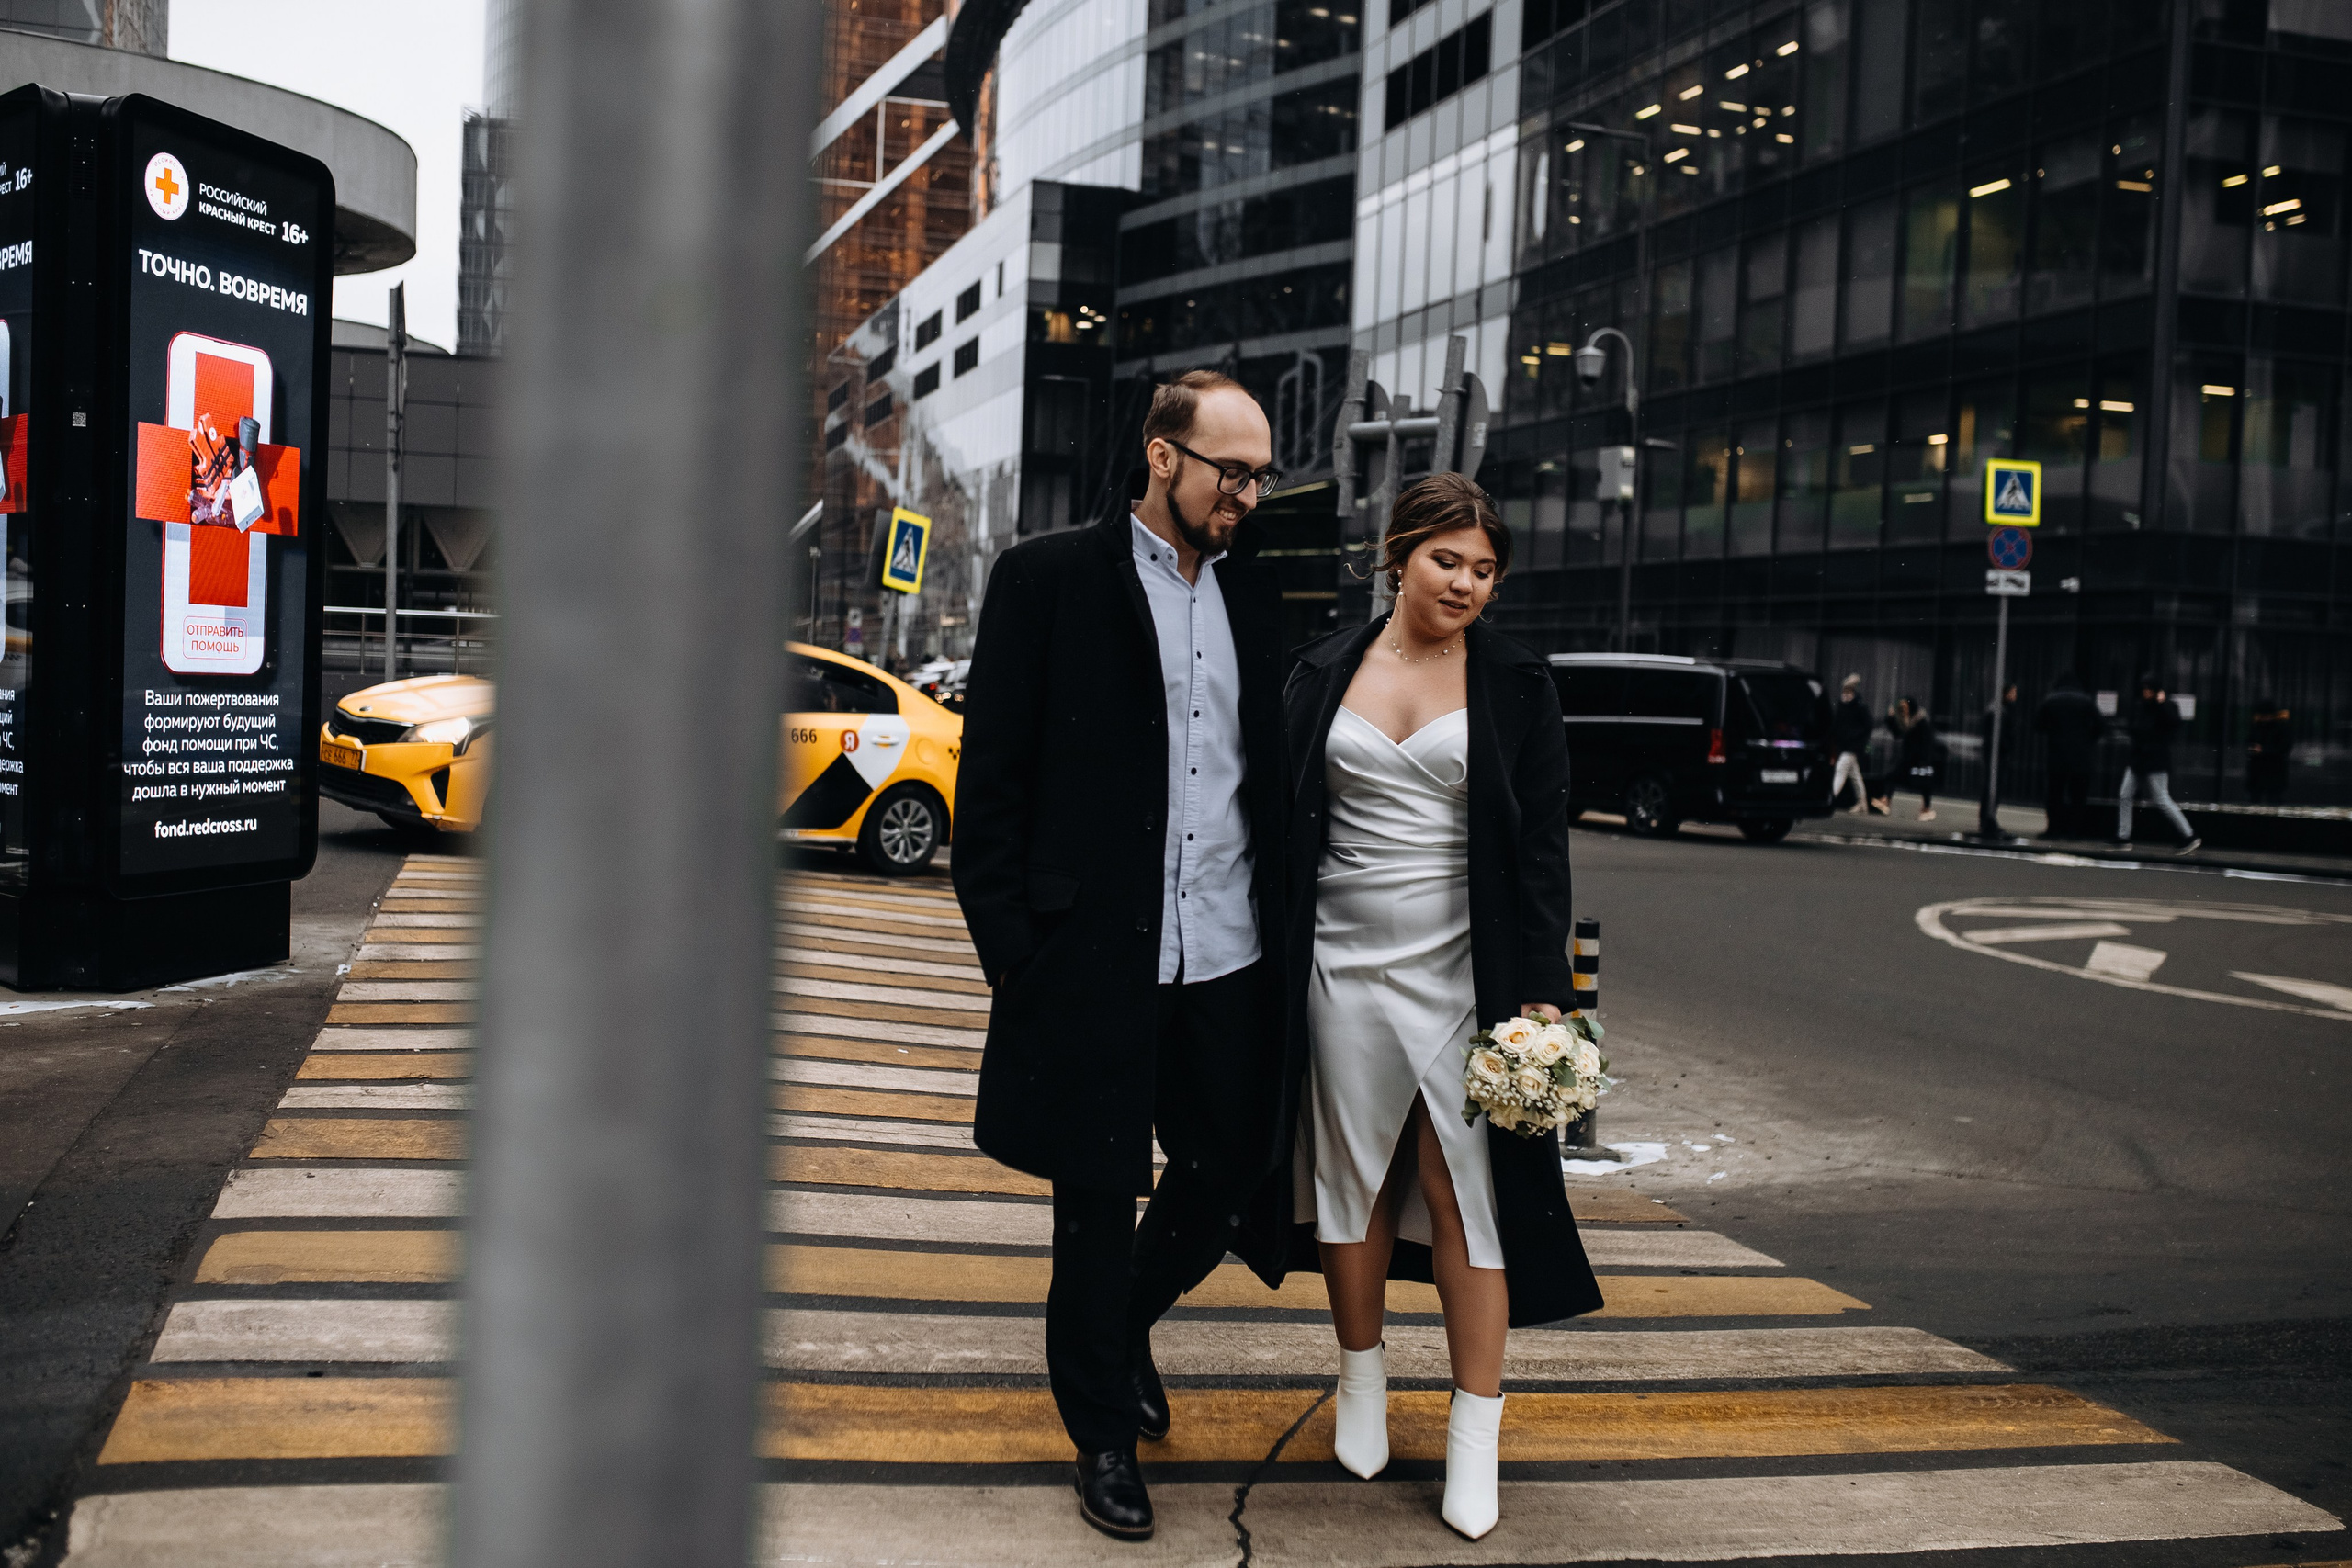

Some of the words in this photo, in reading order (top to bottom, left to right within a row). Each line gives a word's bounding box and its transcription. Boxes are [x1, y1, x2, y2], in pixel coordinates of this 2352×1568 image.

[15, 167, 33, 191] 16+
[198, 183, 267, 216] РОССИЙСКИЙ
[198, 201, 246, 227] КРАСНЫЙ
[247, 218, 276, 236] КРЕСТ
[281, 221, 309, 244] 16+
[138, 248, 215, 291] ТОЧНО.
[219, 271, 308, 316] ВОВРЕМЯ
[187, 625, 244, 637] ОТПРАВИТЬ
[191, 640, 240, 654] ПОМОЩЬ
[145, 689, 182, 706] Ваши
[185, 694, 279, 710] пожертвования
[144, 713, 220, 733] формируют
[222, 713, 276, 732] будущий
[142, 736, 178, 757] фонд
[181, 738, 232, 752] помощи
[235, 738, 257, 753] при
[259, 733, 279, 751] ЧС,
[791, 728, 817, 744] 666
[123, 760, 164, 776] чтобы
[168, 761, 189, 774] вся
[193, 761, 225, 773] ваша
[228, 758, 294, 774] поддержка
[132, 785, 177, 802] дошла
[180, 784, 188, 796] в
[191, 779, 240, 800] нужный
[243, 779, 286, 794] момент
[154, 818, 257, 838] fond.redcross.ru
